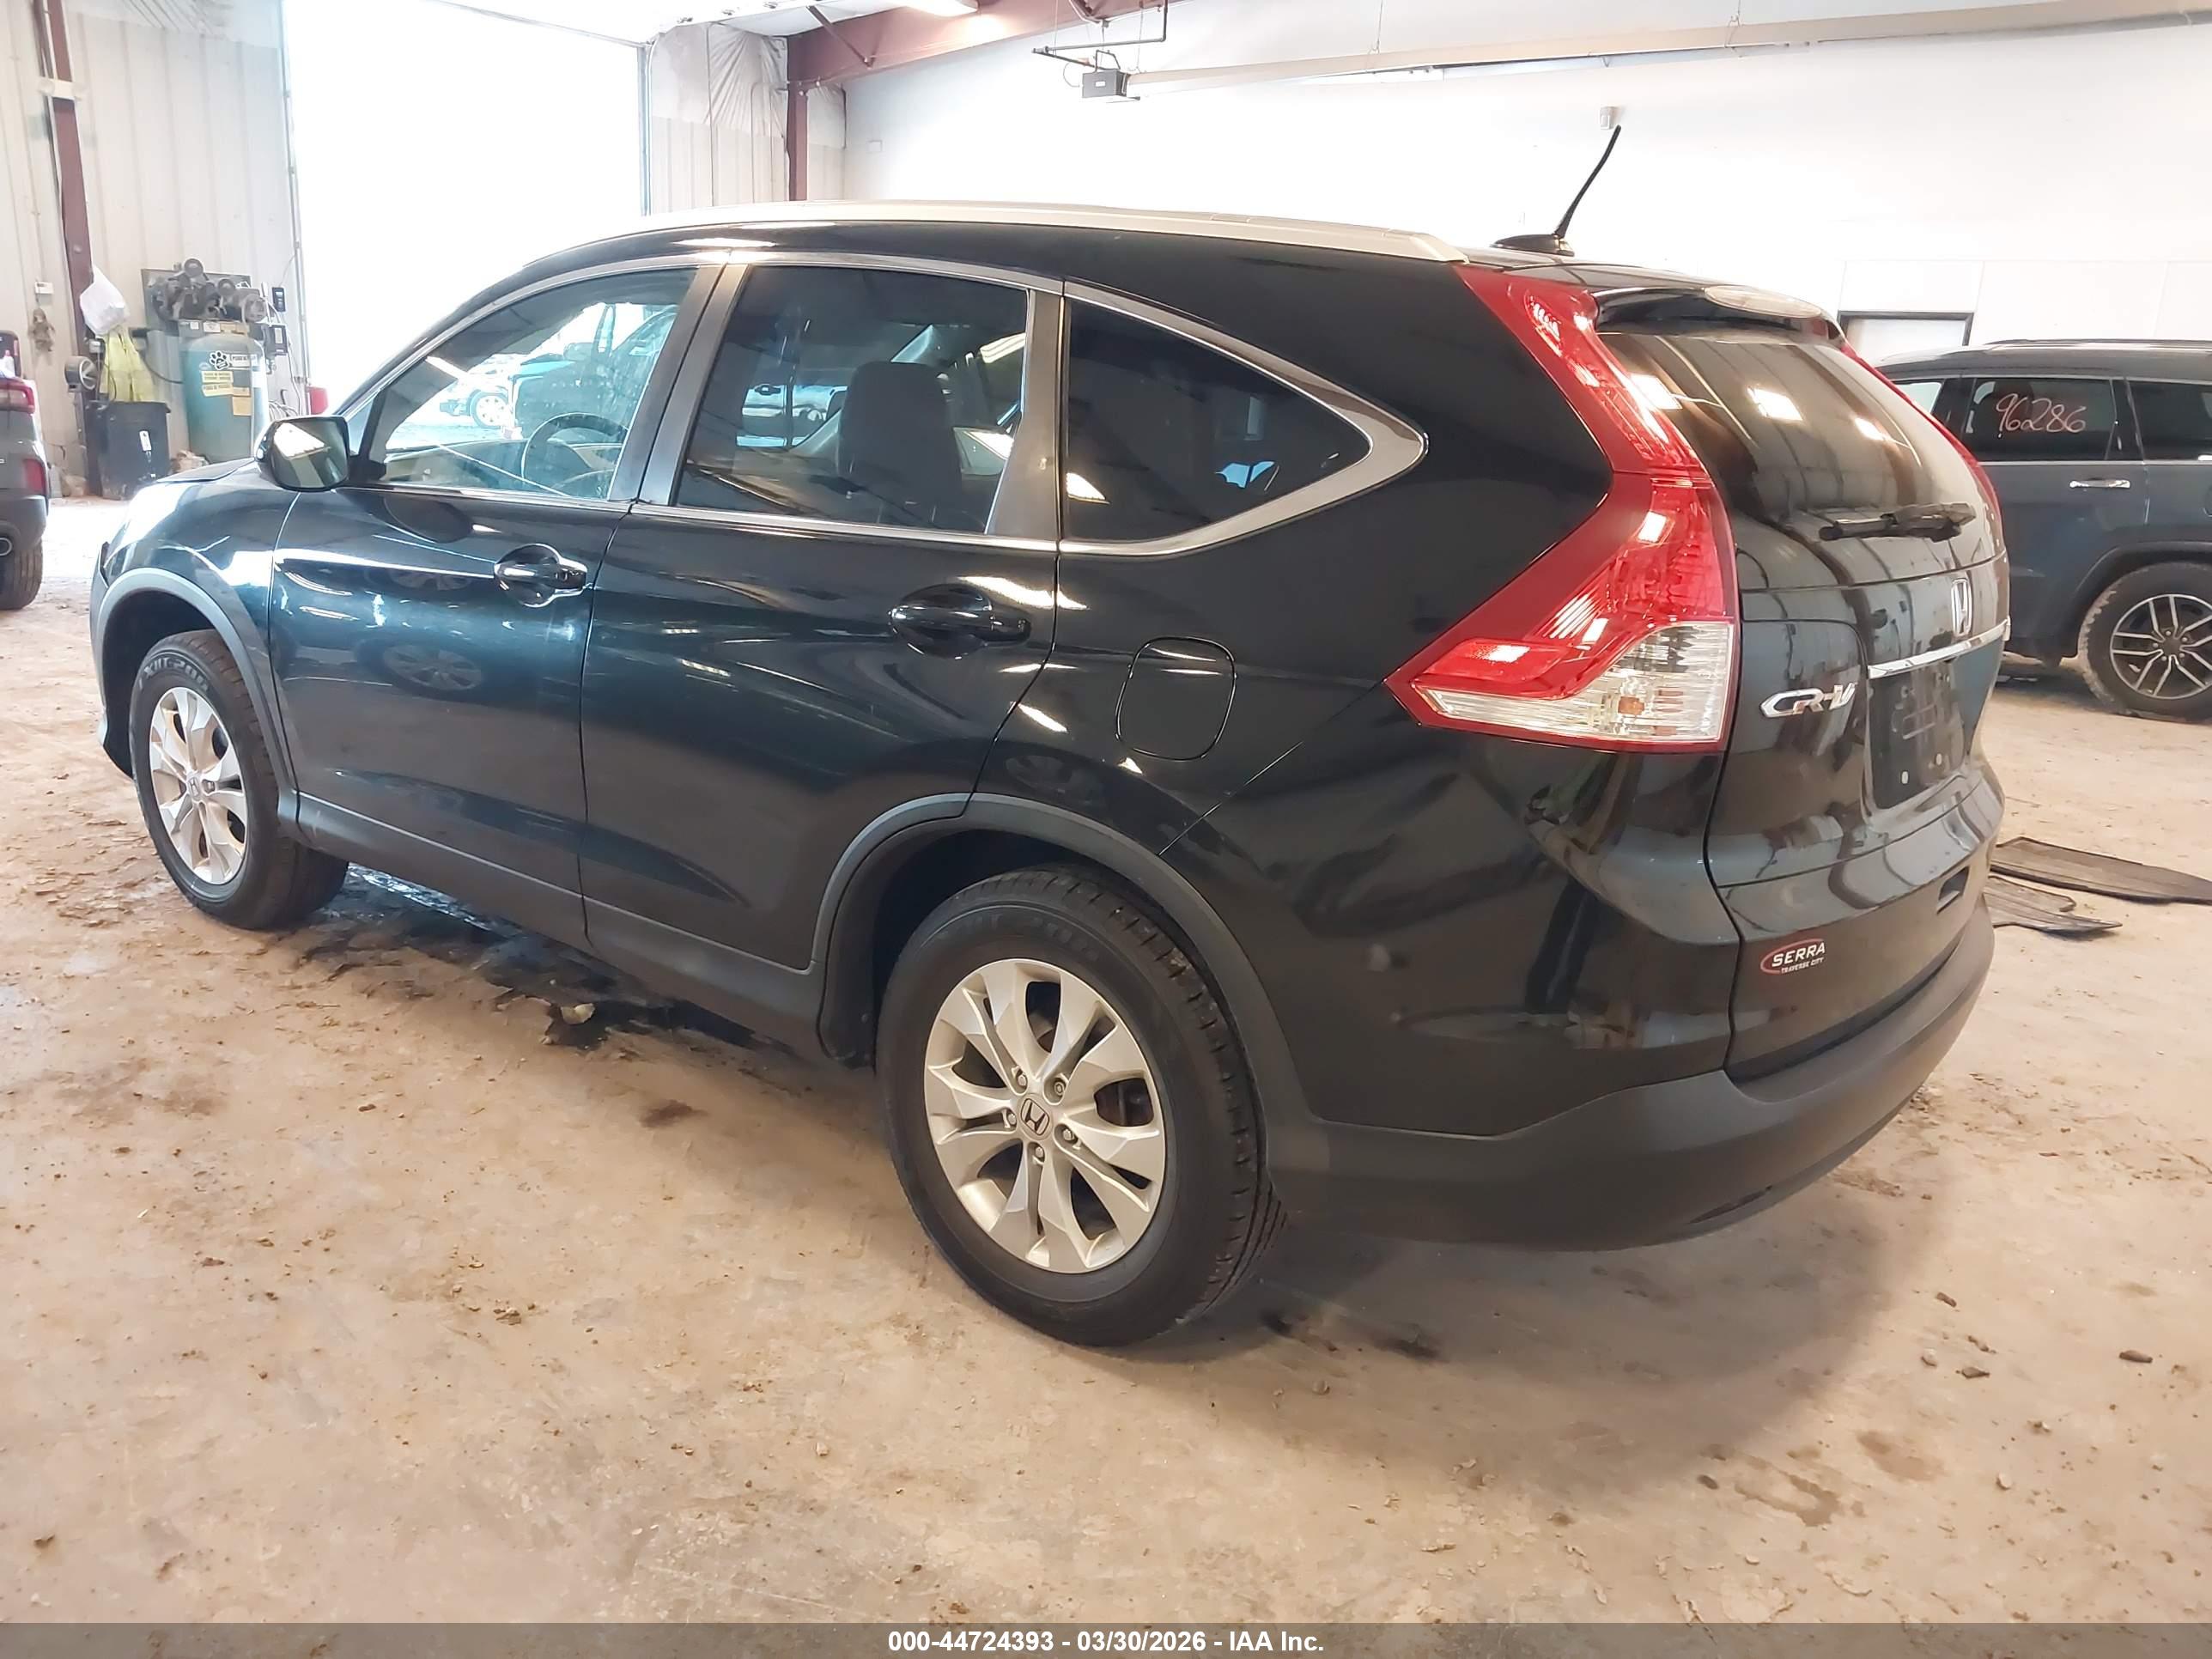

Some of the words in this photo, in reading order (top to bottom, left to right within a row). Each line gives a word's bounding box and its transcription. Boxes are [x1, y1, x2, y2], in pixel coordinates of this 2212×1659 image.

[1996, 392, 2087, 433] 96286
[1760, 682, 1856, 718] CR-V
[1771, 942, 1826, 967] SERRA
[1810, 957, 1825, 966] CITY
